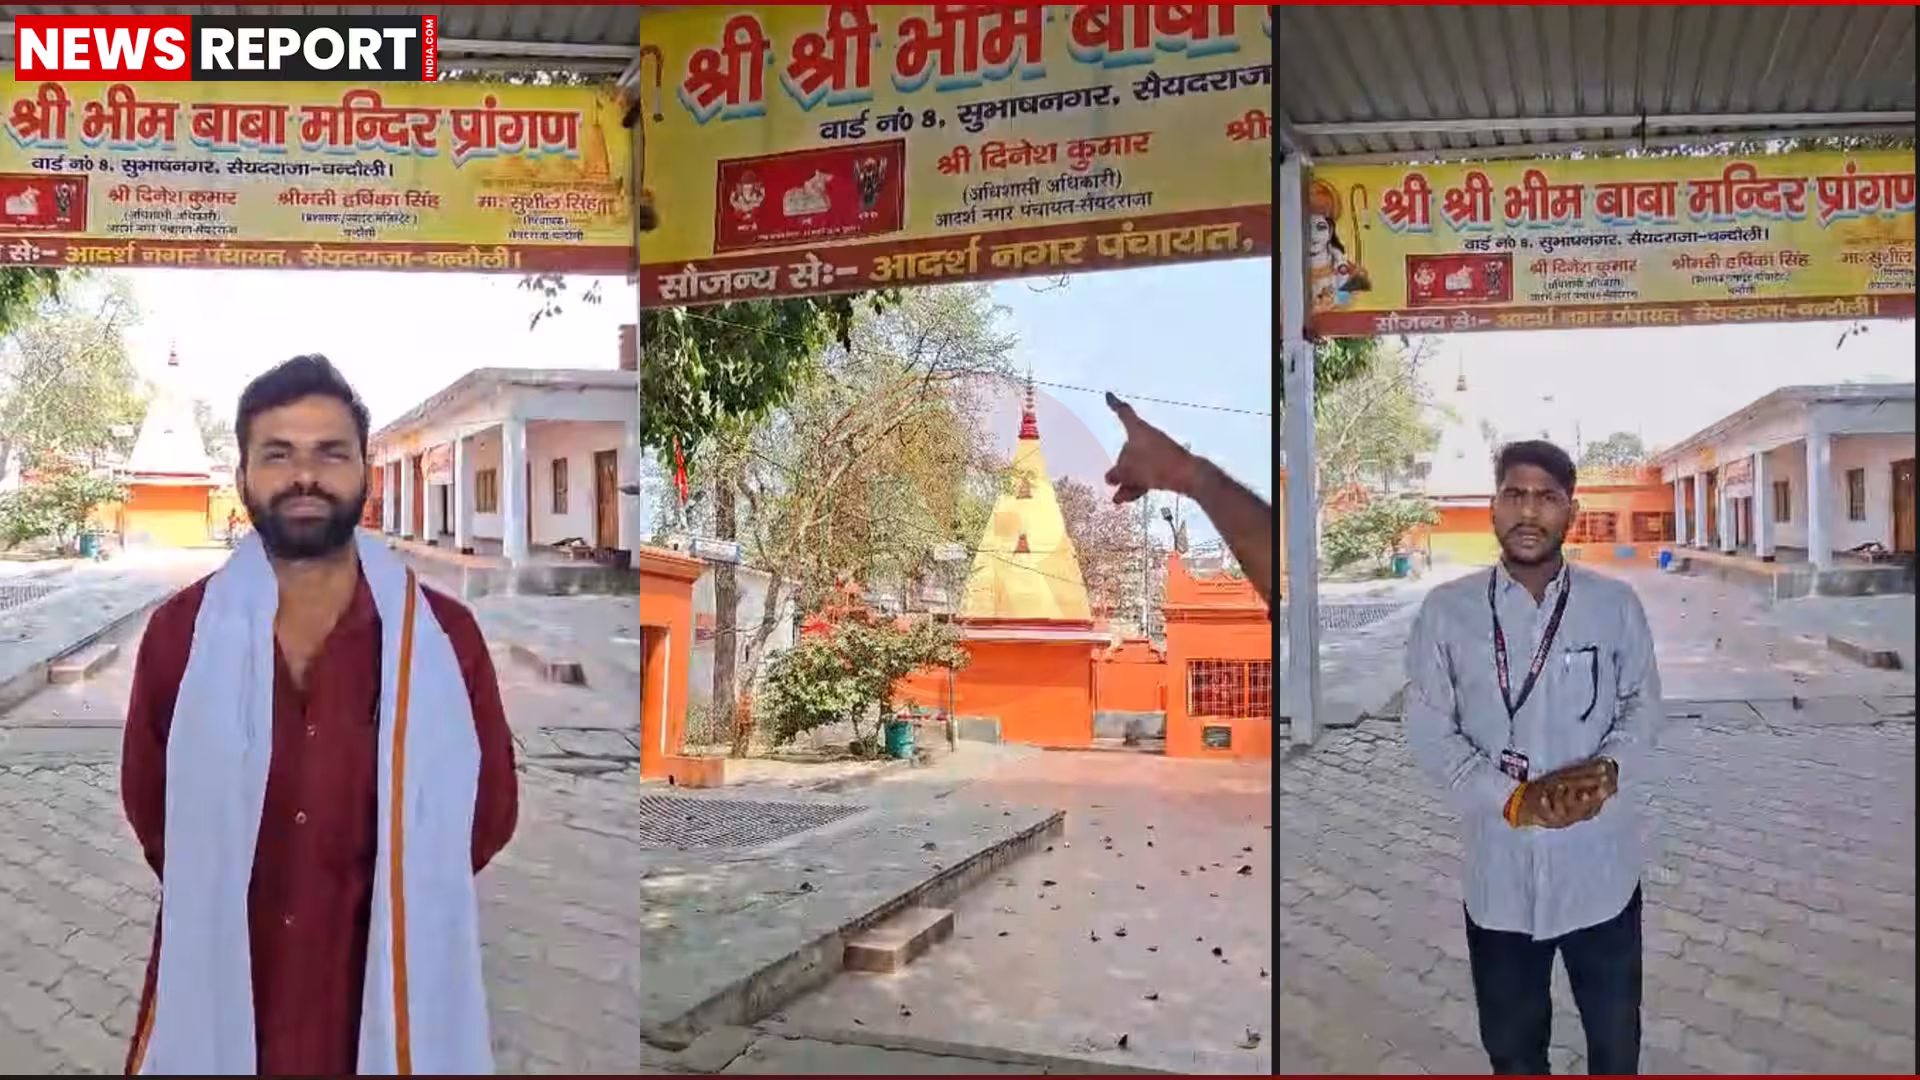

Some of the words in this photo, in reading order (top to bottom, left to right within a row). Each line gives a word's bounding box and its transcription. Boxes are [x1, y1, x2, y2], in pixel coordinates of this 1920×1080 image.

[679, 15, 771, 124] श्री
[781, 5, 878, 112] श्री
[820, 109, 869, 139] वार्ड
[921, 110, 946, 128] 8,
[957, 84, 1120, 132] सुभाषनगर,
[1132, 64, 1272, 101] सैयदराज
[7, 82, 71, 147] श्री
[82, 83, 180, 149] भीम
[191, 102, 289, 152] बाबा
[301, 89, 442, 155] मन्दिर
[449, 95, 581, 165] प्रांगण
[1226, 110, 1272, 141] श्री
[31, 155, 63, 171] वार्ड
[937, 144, 971, 176] श्री
[981, 139, 1058, 172] दिनेश
[1067, 131, 1153, 171] कुमार
[1046, 168, 1122, 195] अधिकारी)
[108, 184, 130, 203] श्री
[136, 185, 183, 204] दिनेश
[187, 188, 239, 209] कुमार
[278, 187, 338, 207] श्रीमती
[405, 190, 441, 208] सिंह
[511, 192, 561, 215] सुशील
[1379, 173, 1433, 232] श्री
[1441, 171, 1494, 232] श्री
[1504, 169, 1585, 228] भीम
[1594, 182, 1678, 225] बाबा
[1687, 161, 1809, 223] मन्दिर
[982, 205, 1014, 222] नगर
[65, 241, 137, 265] आदर्श
[1464, 235, 1492, 250] वार्ड
[658, 262, 780, 300] सौजन्य
[870, 235, 981, 283] आदर्श
[991, 236, 1089, 269] नगर
